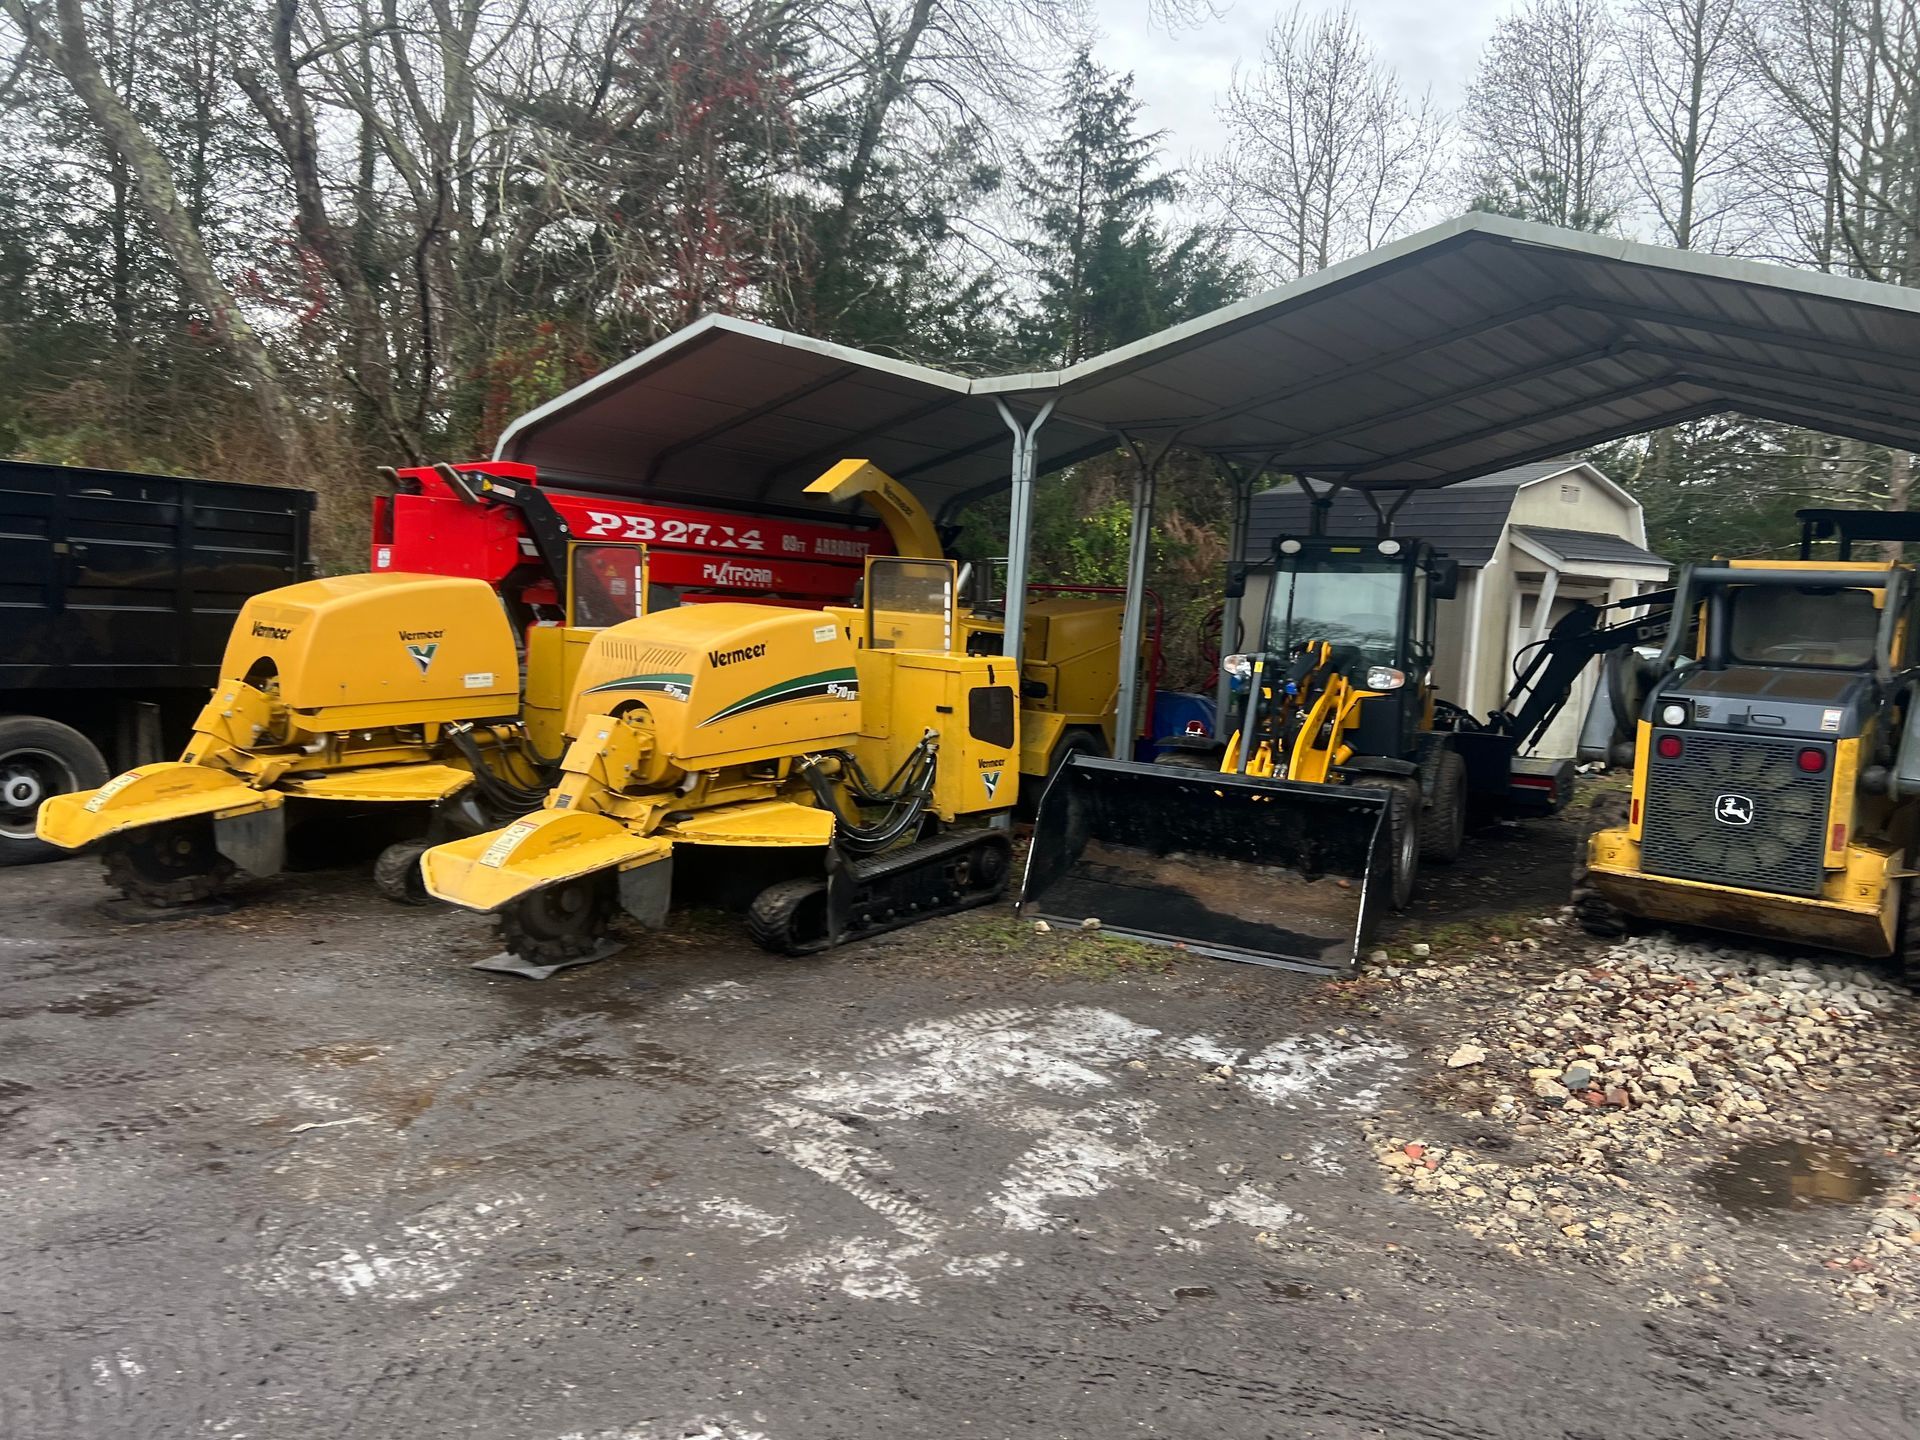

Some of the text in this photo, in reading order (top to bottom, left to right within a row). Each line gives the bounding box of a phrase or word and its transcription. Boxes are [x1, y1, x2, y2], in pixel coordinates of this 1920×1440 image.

[814, 538, 870, 557] ARBORIST
[252, 621, 291, 640] Vermeer
[399, 629, 444, 641] Vermeer
[708, 642, 767, 668] Vermeer
